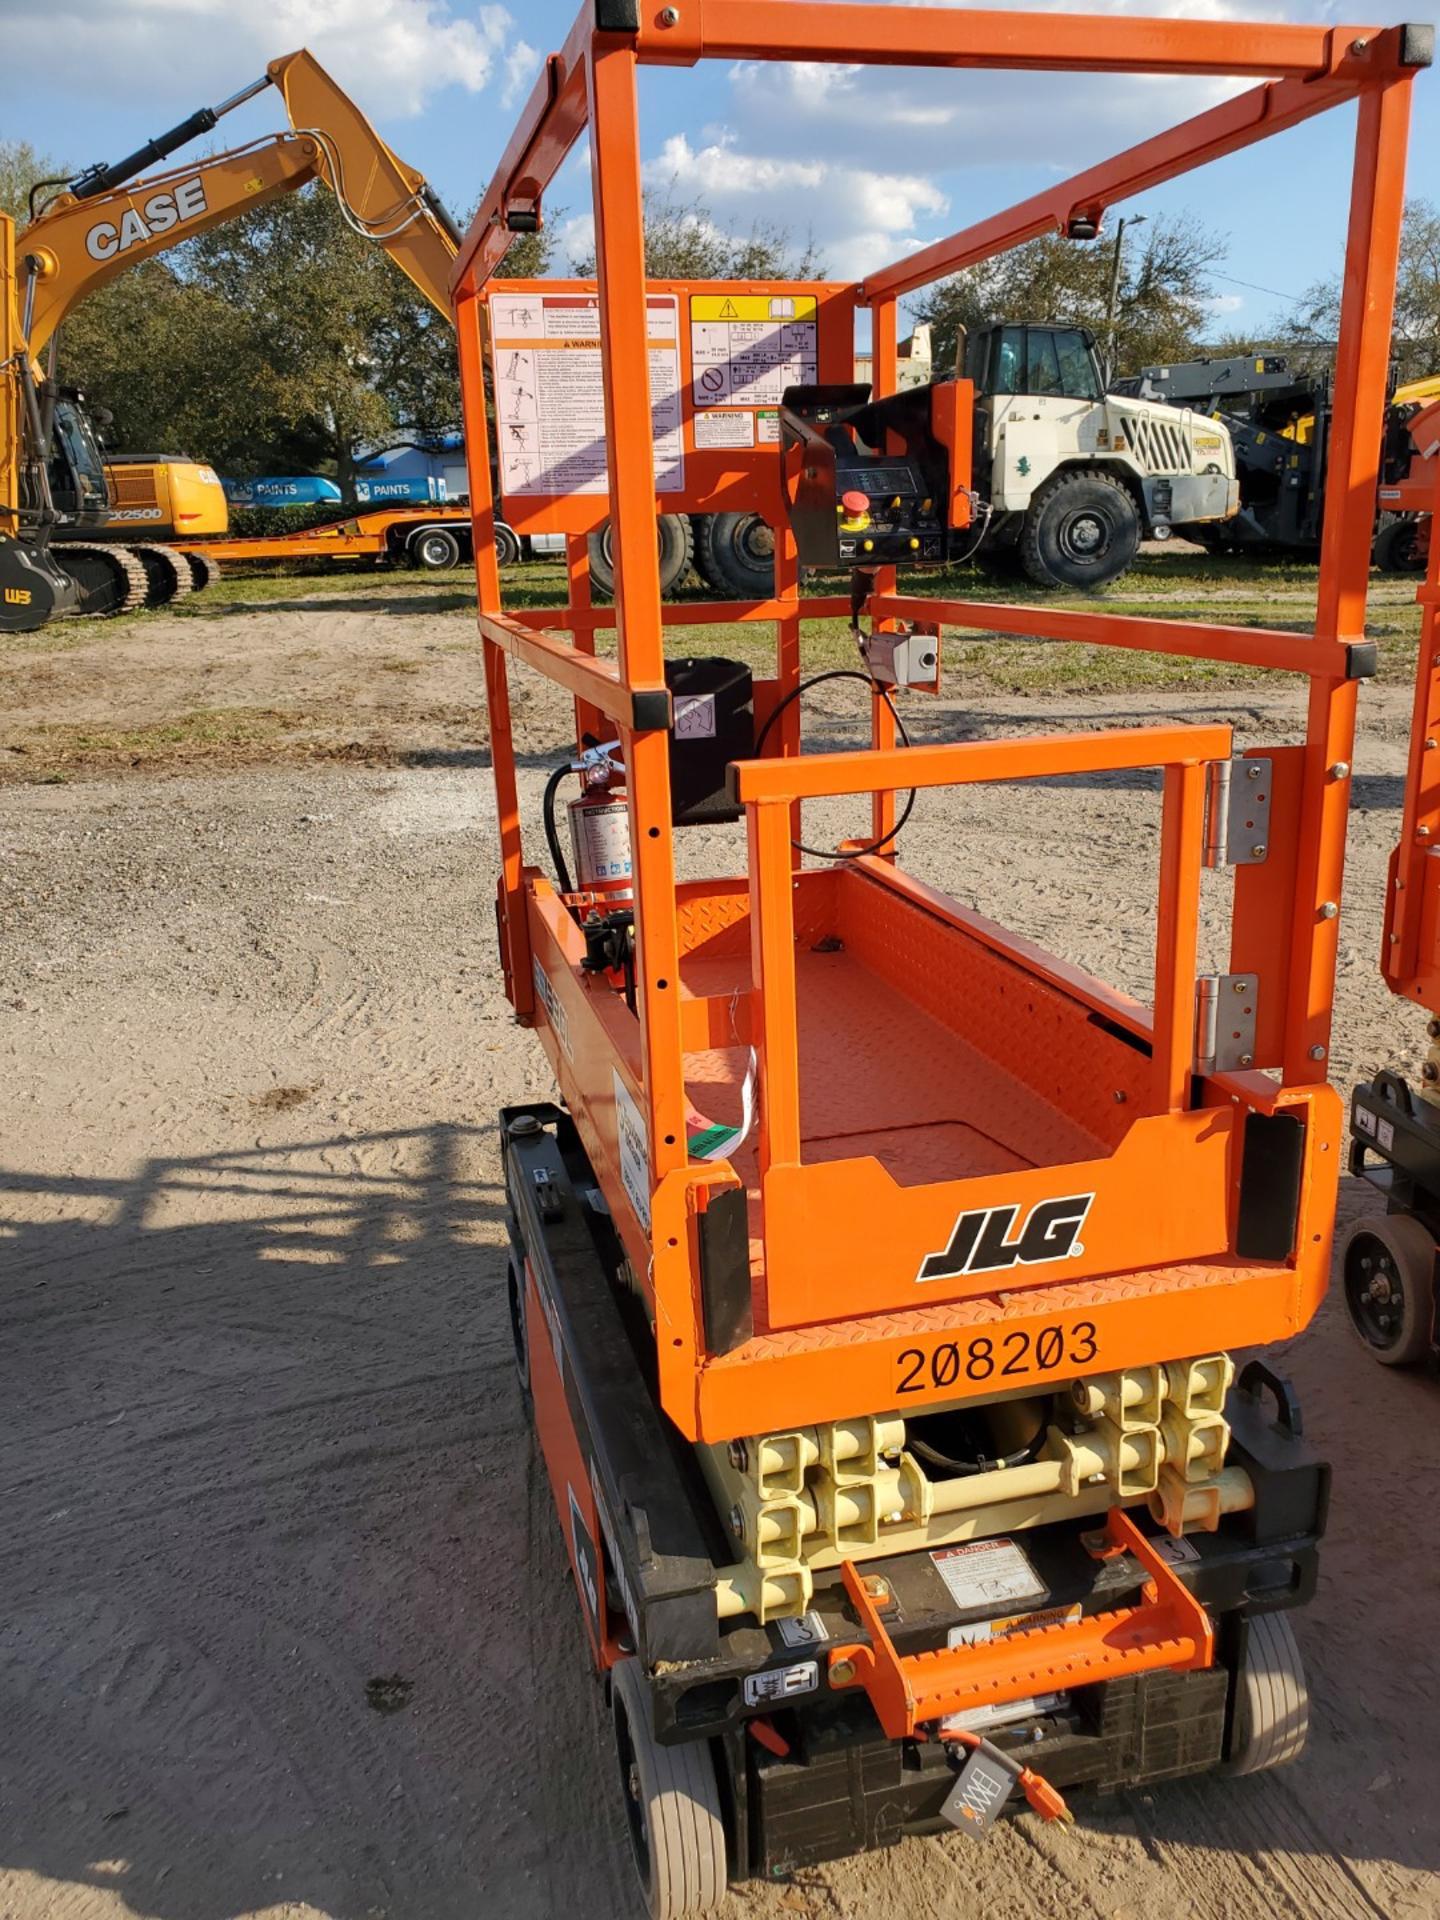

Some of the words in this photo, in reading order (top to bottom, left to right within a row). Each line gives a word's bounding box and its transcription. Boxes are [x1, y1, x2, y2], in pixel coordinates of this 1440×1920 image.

[85, 175, 208, 261] CASE
[256, 483, 298, 496] PAINTS
[373, 484, 411, 496] PAINTS
[916, 1191, 1096, 1283] JLG
[956, 1541, 1000, 1557] DANGER
